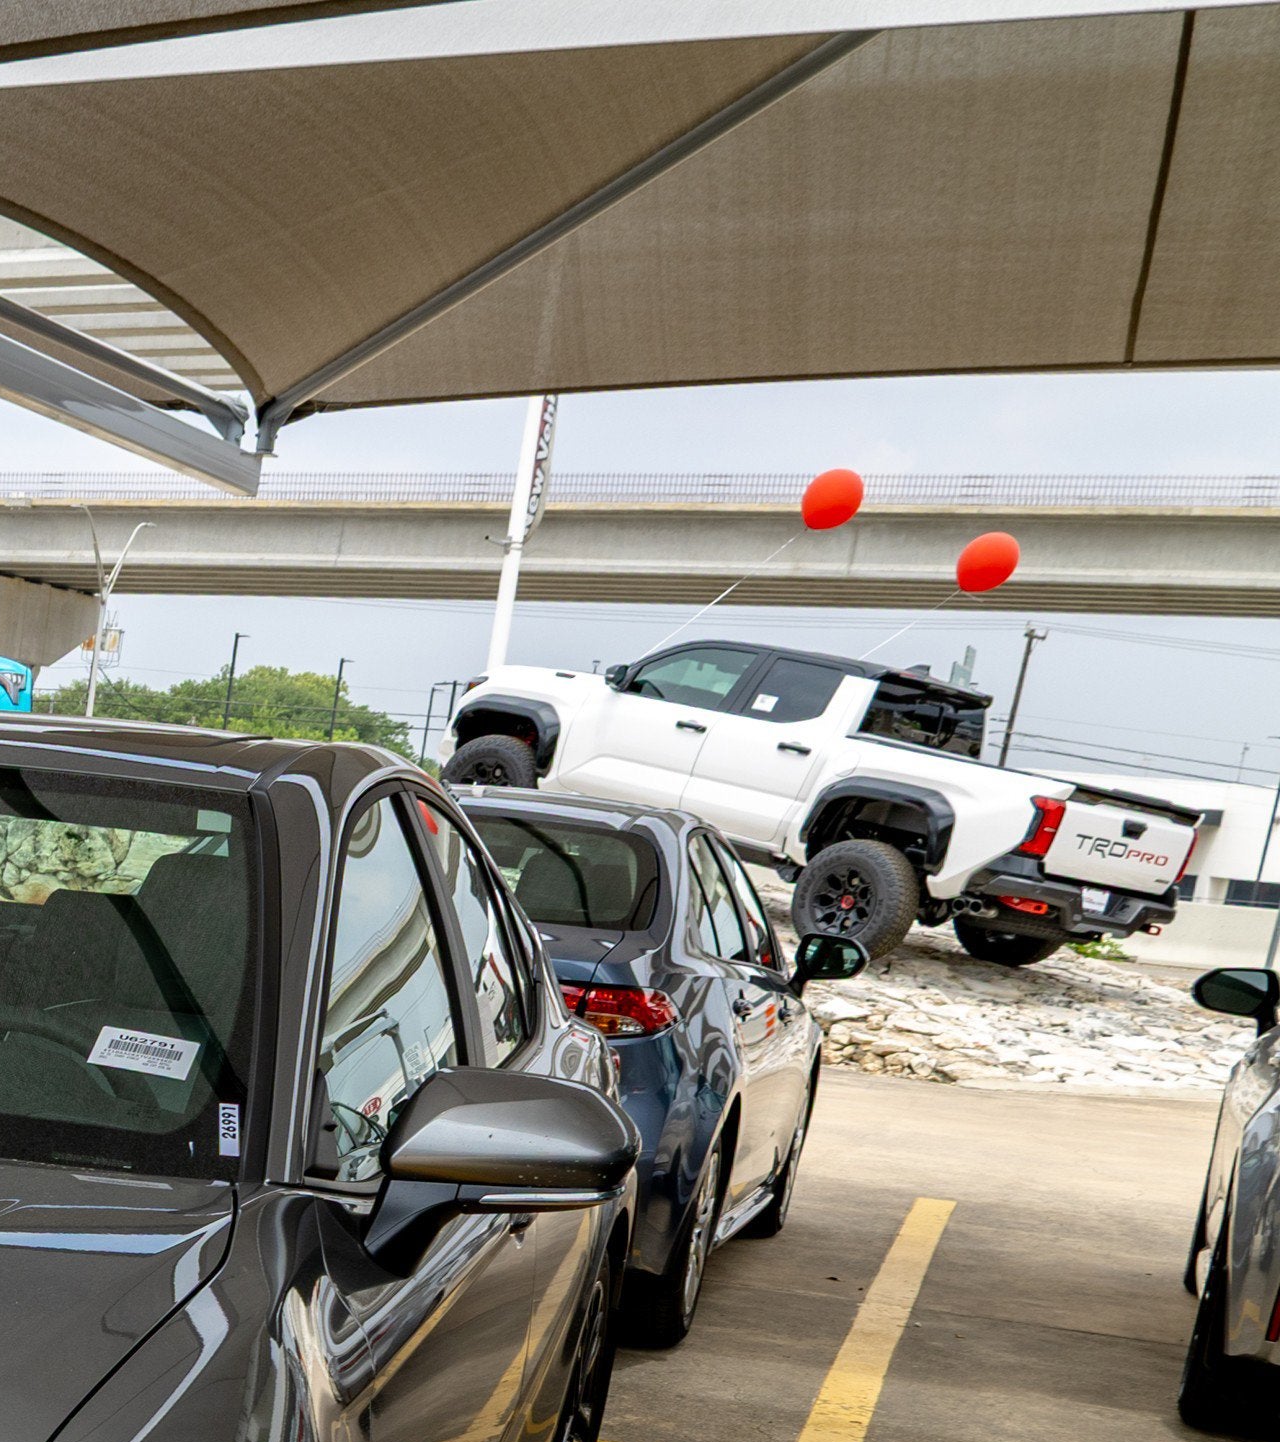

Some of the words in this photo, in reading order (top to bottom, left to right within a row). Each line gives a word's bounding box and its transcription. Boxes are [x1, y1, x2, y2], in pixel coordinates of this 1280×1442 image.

[1076, 834, 1129, 858] TRD
[1125, 849, 1169, 867] PRO
[119, 1034, 176, 1049] U62791
[221, 1106, 237, 1139] 26991
